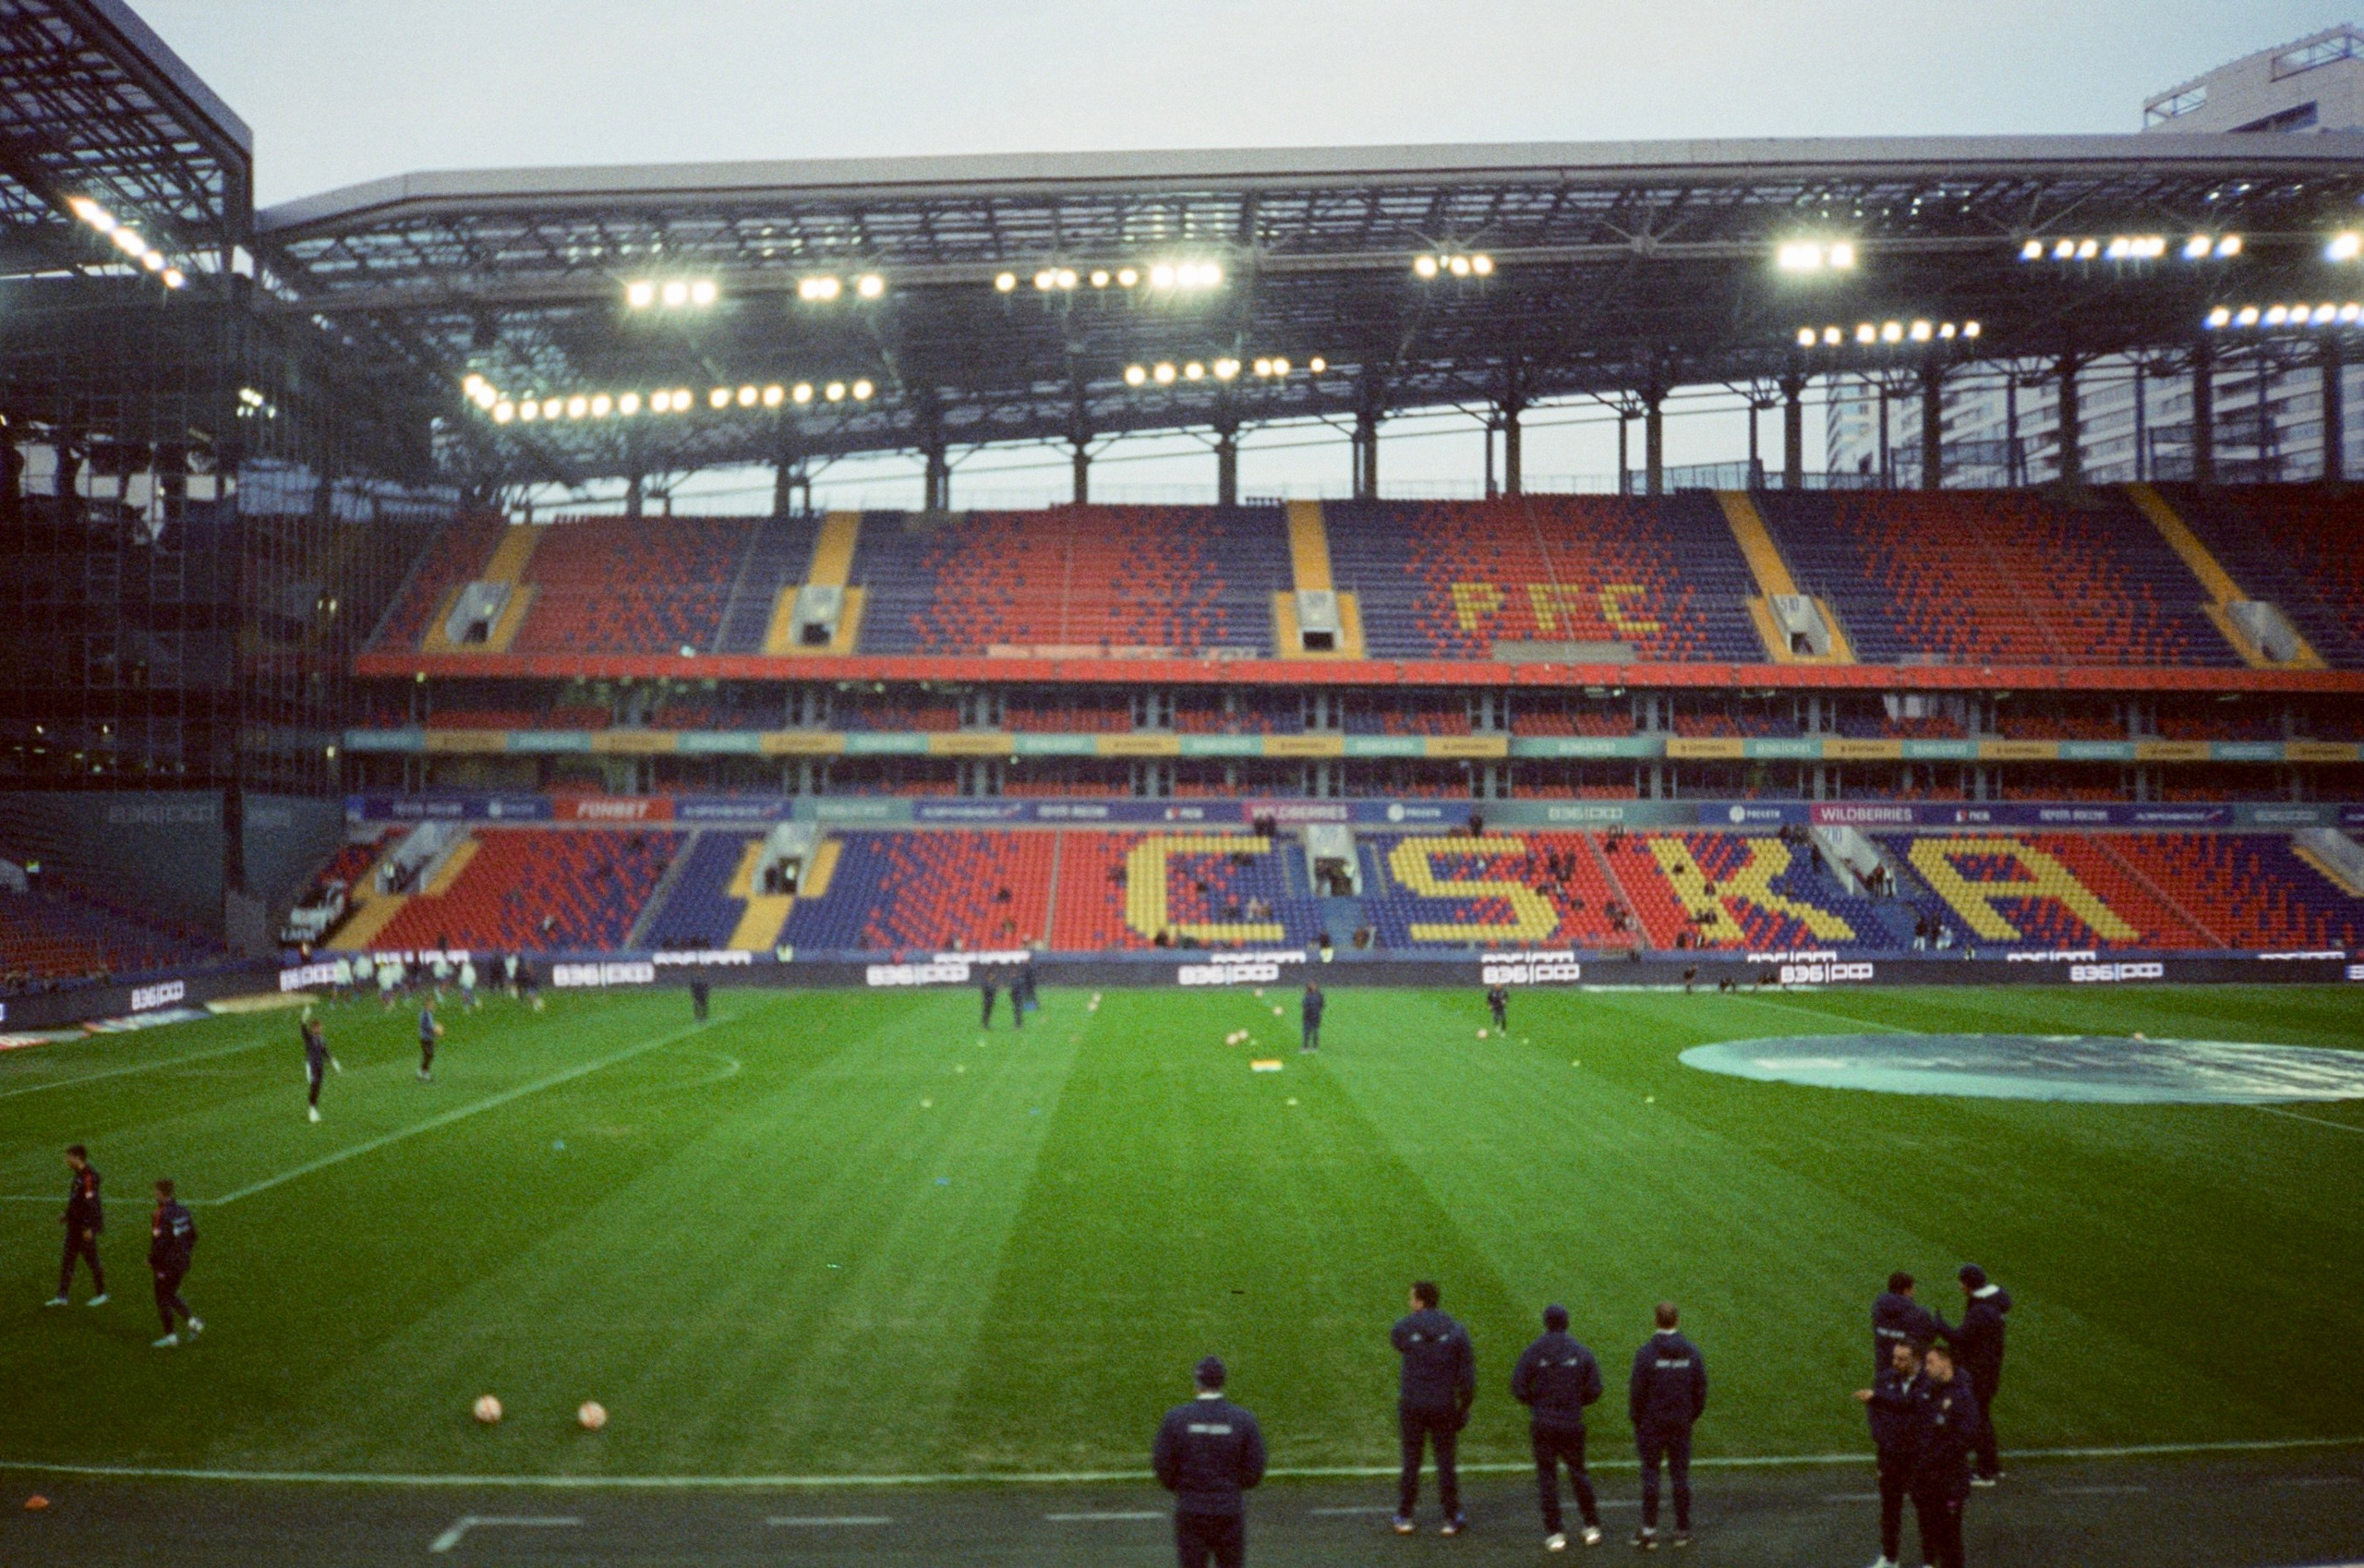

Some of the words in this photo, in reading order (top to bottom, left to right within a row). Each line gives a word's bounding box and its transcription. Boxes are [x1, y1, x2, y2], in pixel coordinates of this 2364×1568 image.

[1451, 582, 1660, 632] PFC
[1820, 806, 1913, 822] WILDBERRIES
[1126, 835, 2141, 943] CSKA
